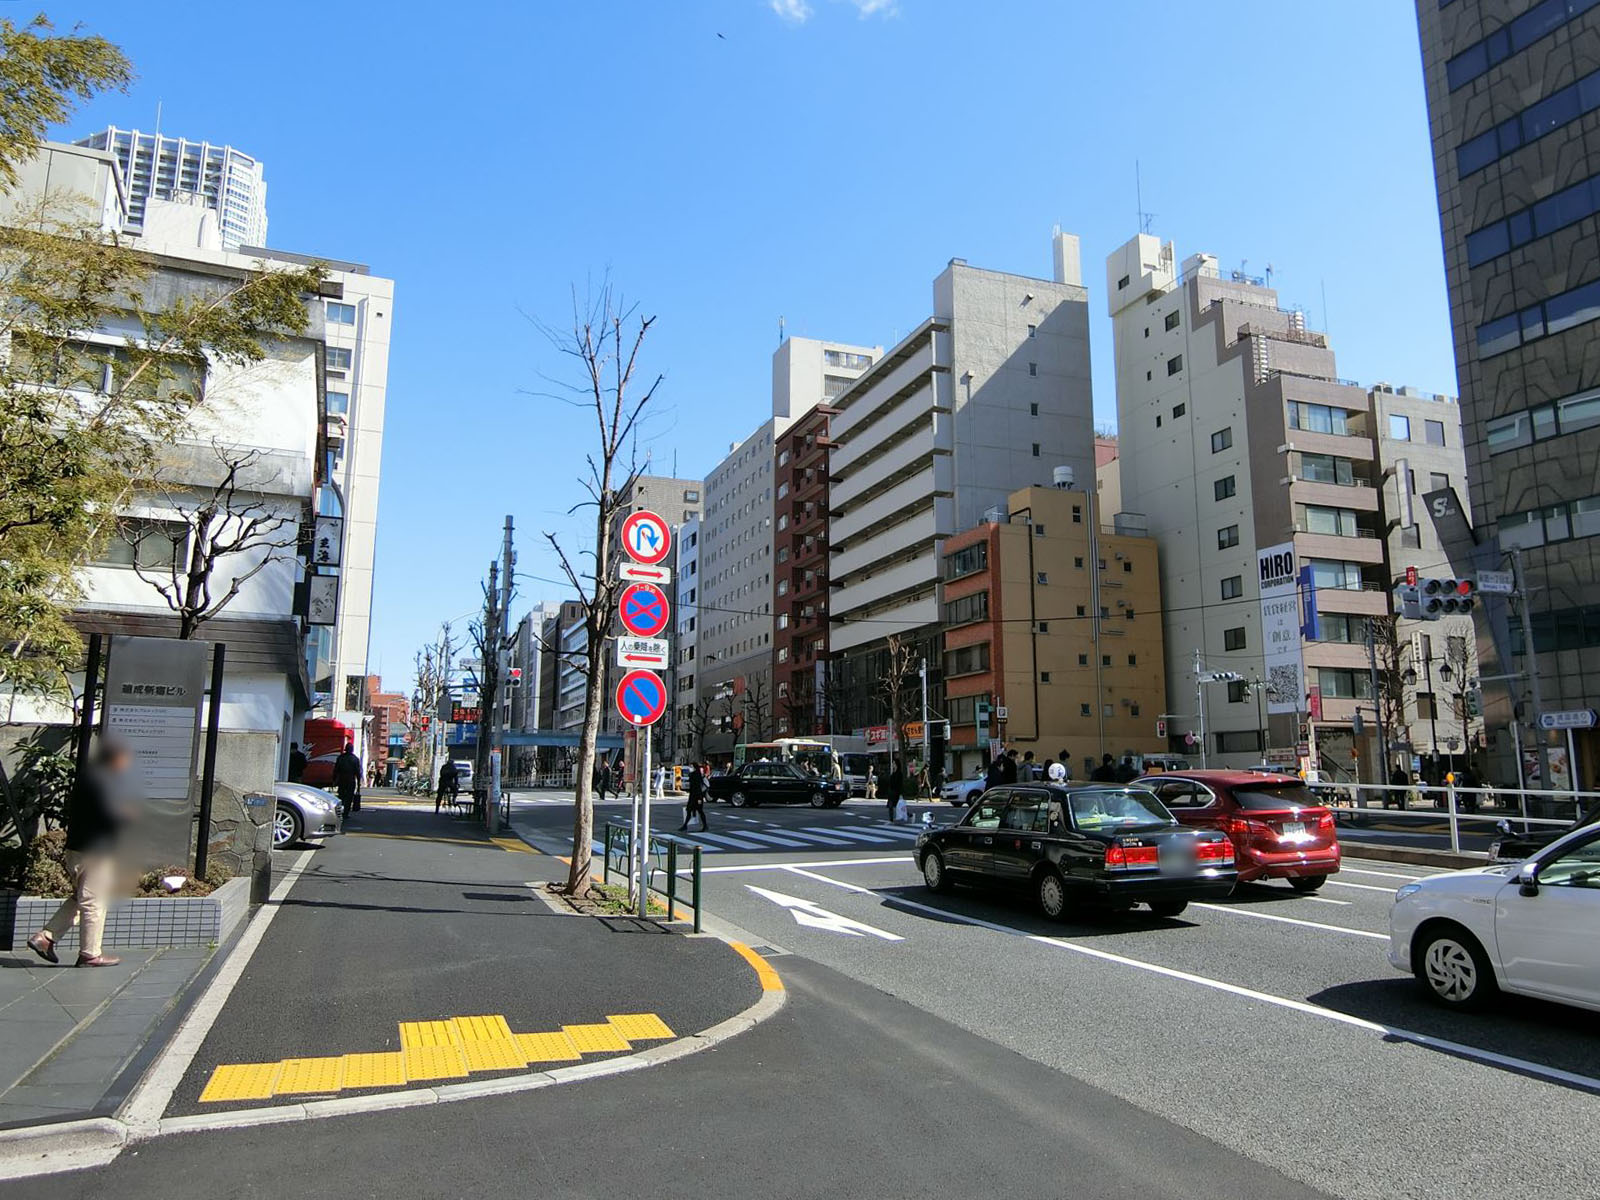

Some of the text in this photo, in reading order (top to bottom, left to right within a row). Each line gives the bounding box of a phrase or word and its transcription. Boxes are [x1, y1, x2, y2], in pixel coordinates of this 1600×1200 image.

[1260, 552, 1293, 580] HIRO
[1261, 576, 1294, 589] CORPORATION
[620, 641, 665, 653] 人の乗降を除く
